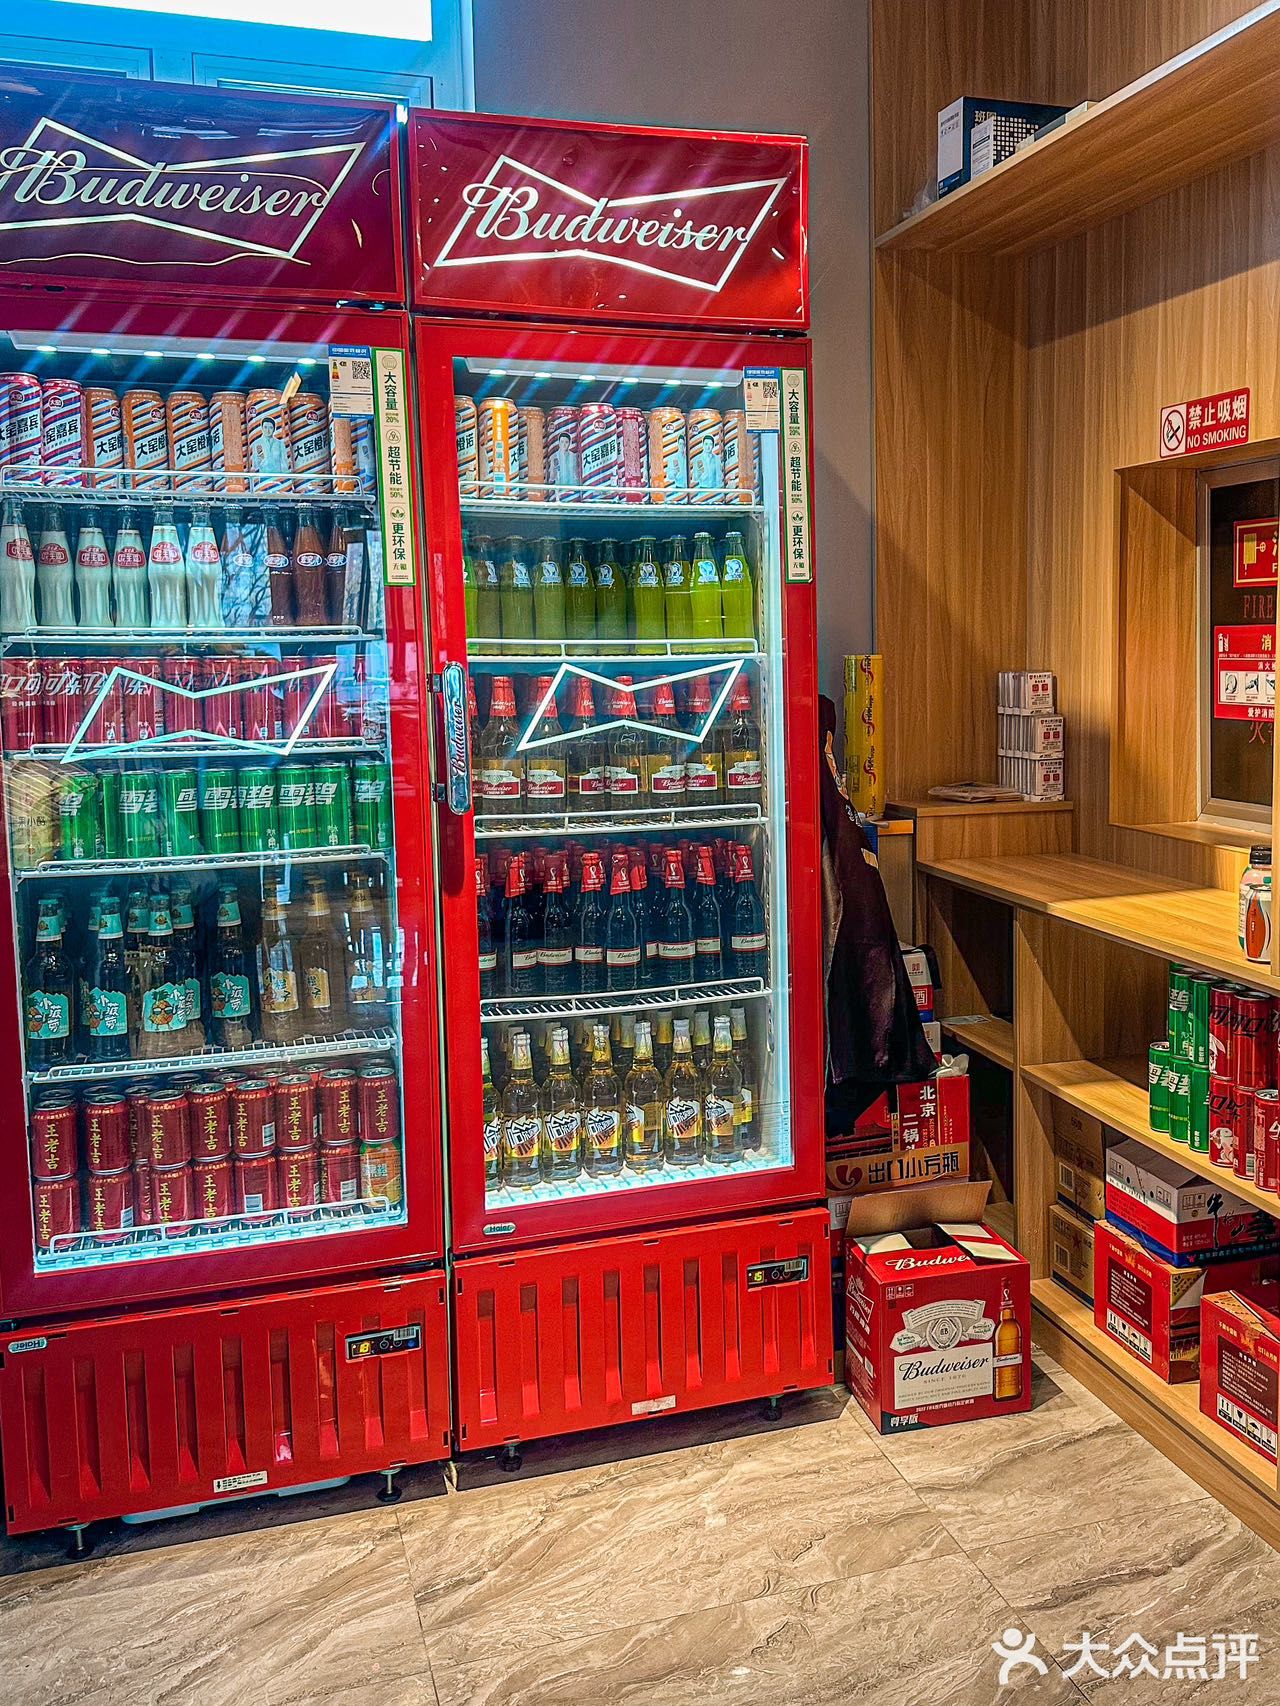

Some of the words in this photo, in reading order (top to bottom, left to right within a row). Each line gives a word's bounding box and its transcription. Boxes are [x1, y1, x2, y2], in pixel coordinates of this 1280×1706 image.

[0, 147, 326, 217] Budweiser
[462, 183, 748, 252] Budweiser
[384, 371, 399, 410] 大容量
[788, 389, 799, 425] 大容量
[1189, 394, 1247, 430] 禁止吸烟
[42, 418, 78, 447] 窑嘉宾
[1187, 434, 1200, 449] NO
[1202, 425, 1247, 446] SMOKING
[388, 446, 405, 485] 超节能
[790, 456, 802, 492] 超节能
[392, 522, 407, 561] 更环保
[792, 525, 804, 560] 更环保
[1243, 595, 1273, 618] FIRE
[451, 699, 467, 776] Budweiser
[483, 784, 512, 792] Budweiser
[288, 1097, 302, 1142] 王老吉
[338, 1090, 351, 1135] 王老吉
[375, 1089, 389, 1134] 王老吉
[920, 1086, 936, 1117] 北京
[90, 1118, 102, 1165] 王老吉
[152, 1114, 164, 1160] 王老吉
[204, 1106, 218, 1151] 王老吉
[237, 1103, 248, 1148] 王老吉
[45, 1124, 60, 1171] 王老吉
[868, 1151, 959, 1184] 出口小方瓶
[203, 1175, 217, 1218] 王老吉
[39, 1195, 52, 1240] 王老吉
[490, 1224, 511, 1232] Haier
[17, 1338, 41, 1351] Haier
[899, 1357, 989, 1381] Budweiser
[890, 1413, 919, 1427] 尊享版
